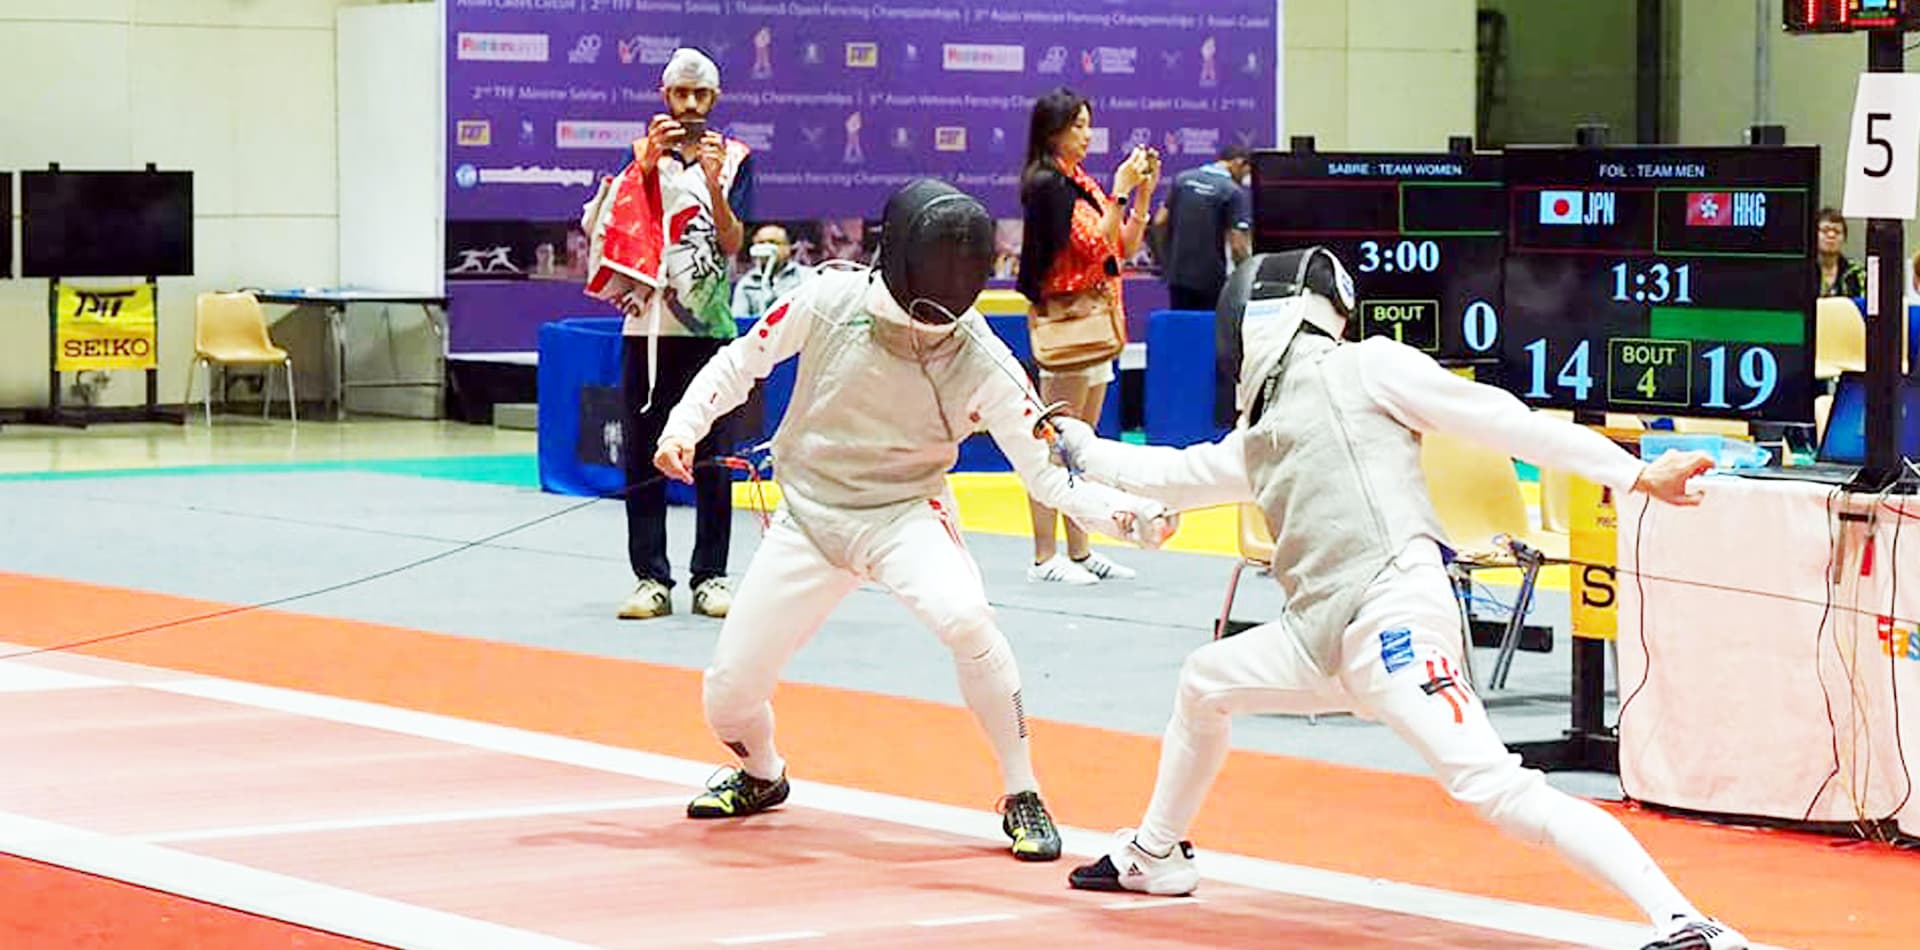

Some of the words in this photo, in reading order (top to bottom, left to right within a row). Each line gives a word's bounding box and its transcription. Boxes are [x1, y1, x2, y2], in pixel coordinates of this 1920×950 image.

[1863, 113, 1893, 177] 5
[1328, 163, 1369, 175] SABRE
[1378, 163, 1412, 175] TEAM
[1414, 164, 1462, 176] WOMEN
[1600, 164, 1627, 177] FOIL
[1637, 164, 1672, 177] TEAM
[1674, 164, 1705, 178] MEN
[1583, 192, 1615, 225] JPN
[1733, 192, 1766, 226] HKG
[1359, 241, 1440, 272] 3:00
[1611, 263, 1692, 302] 1:31
[1374, 306, 1424, 321] BOUT
[1464, 301, 1498, 351] 0
[64, 338, 149, 357] SEIKO
[1622, 346, 1676, 364] BOUT
[1524, 338, 1593, 400] 14
[1636, 367, 1656, 398] 4
[1702, 346, 1777, 409] 19
